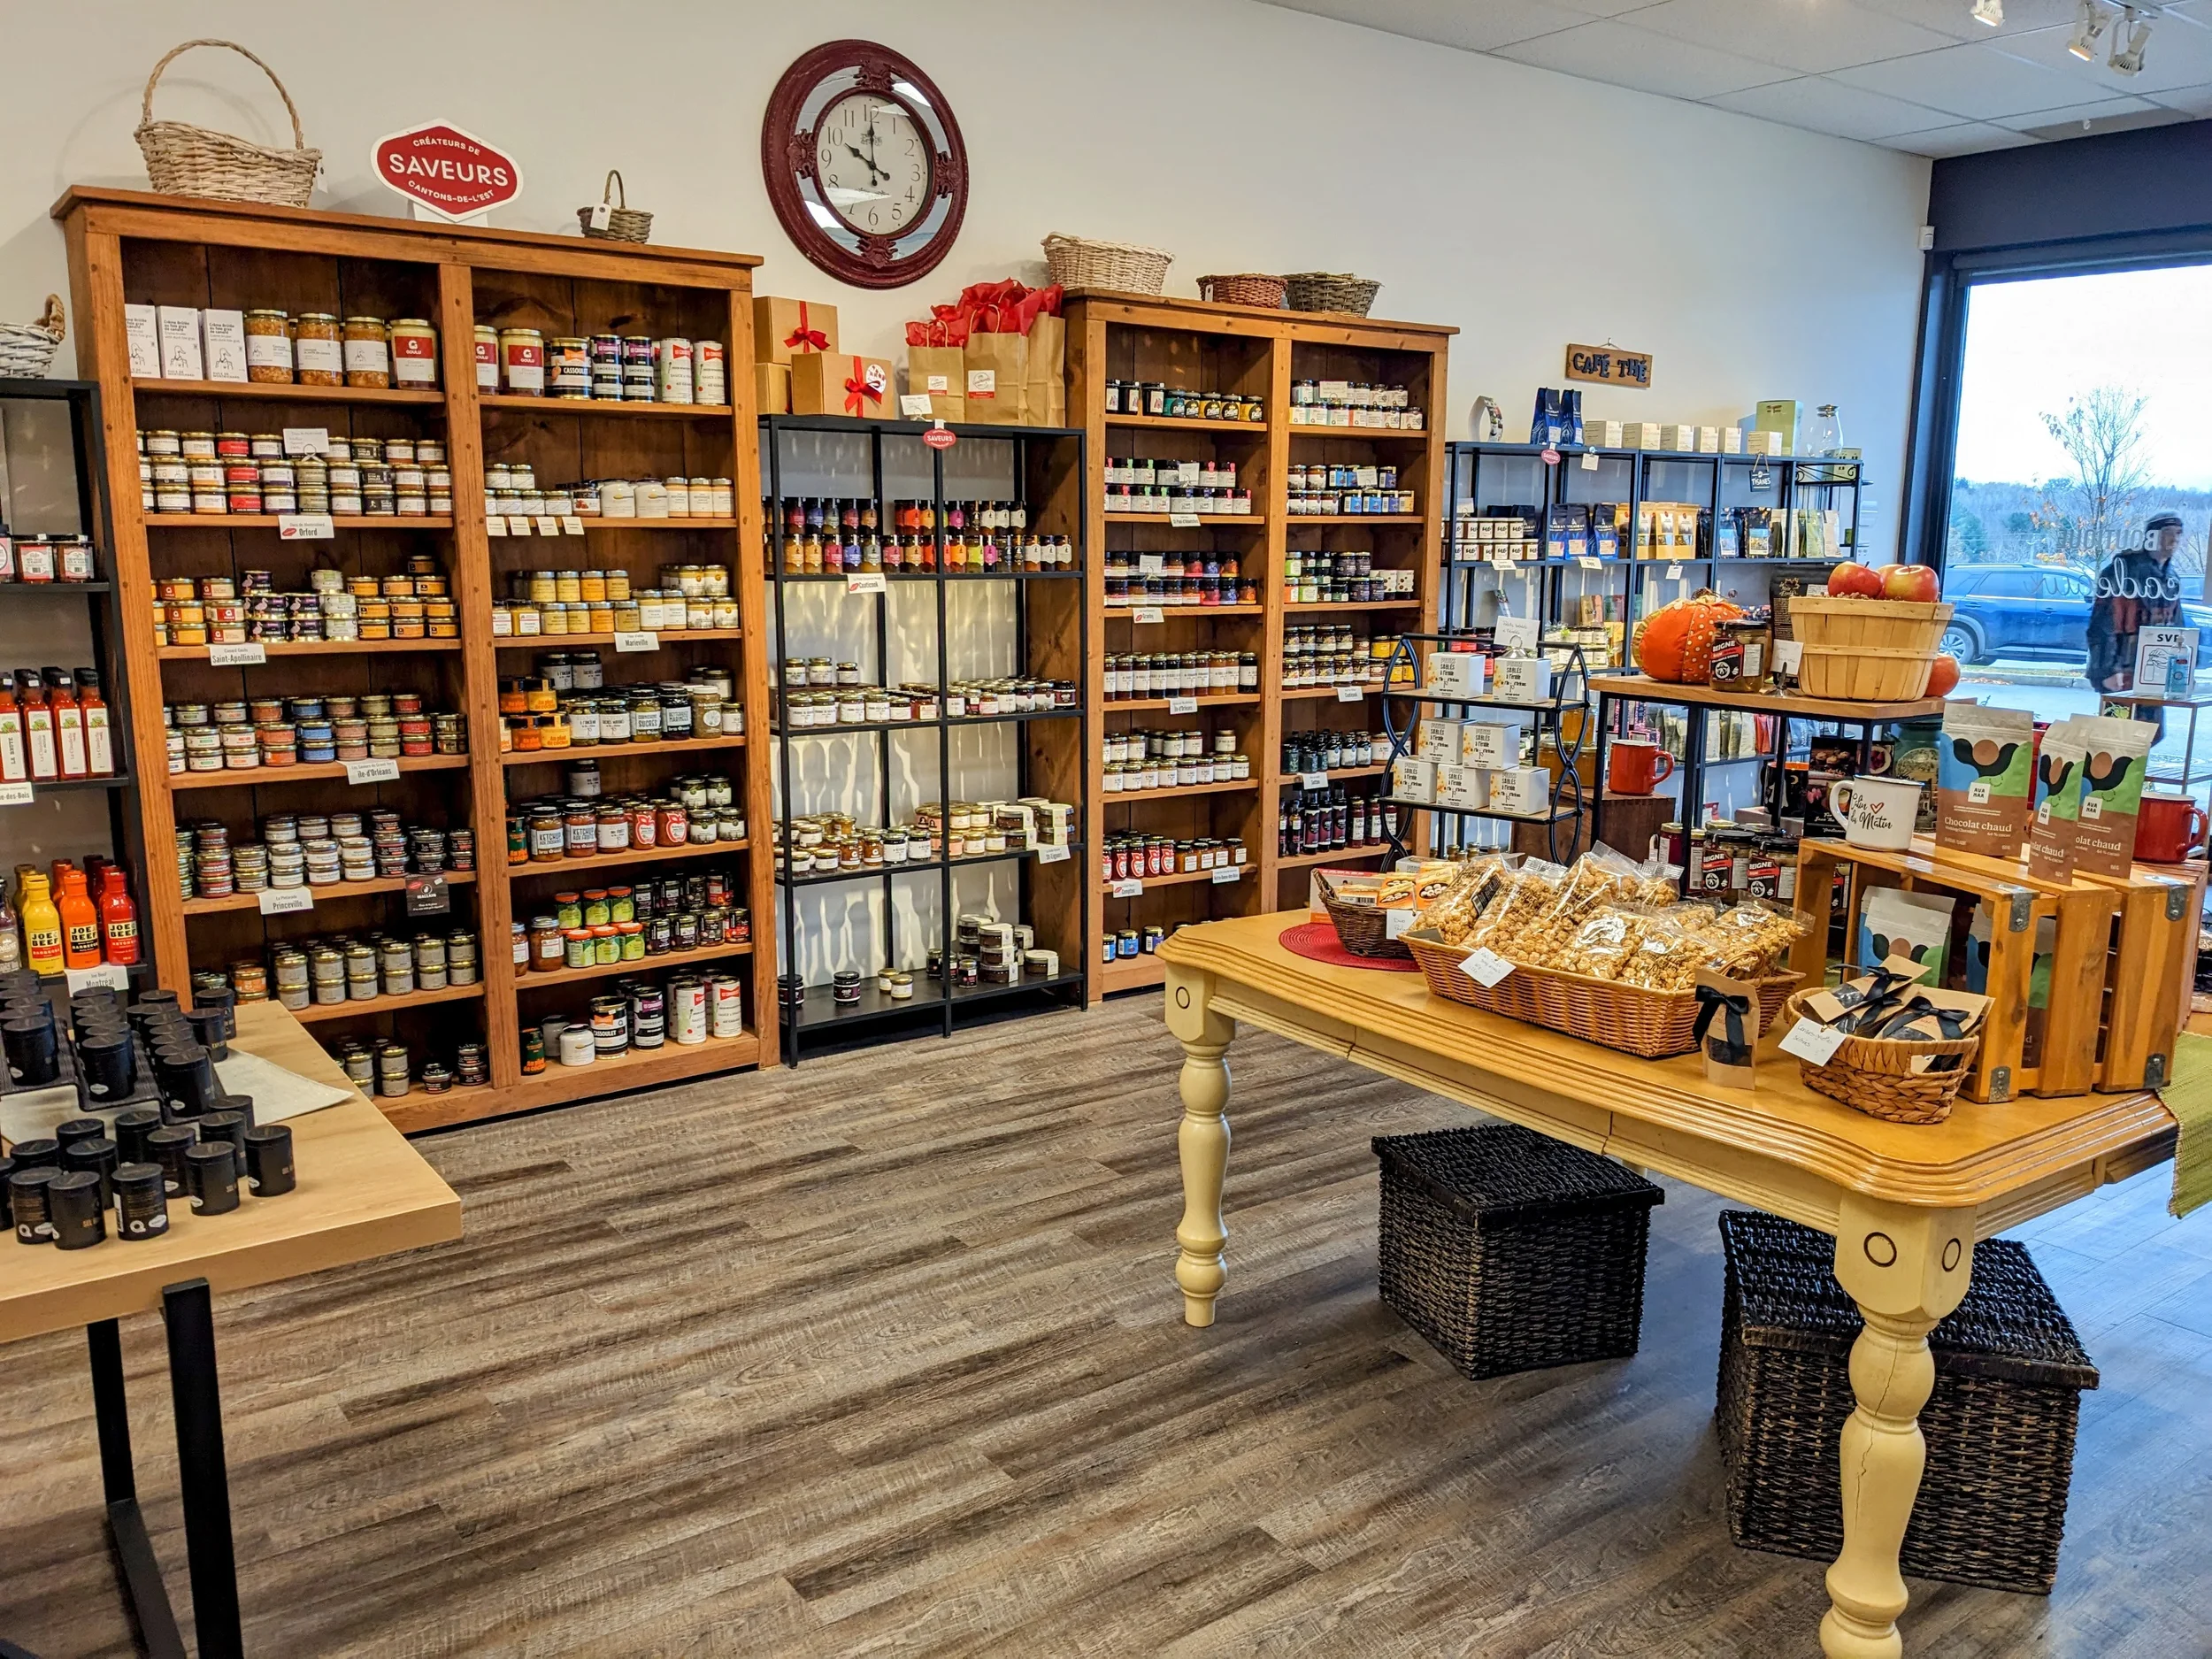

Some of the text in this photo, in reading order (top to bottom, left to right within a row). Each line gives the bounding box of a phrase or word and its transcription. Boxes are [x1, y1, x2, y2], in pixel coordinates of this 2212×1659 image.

[843, 109, 855, 127] 11
[864, 104, 879, 124] 12
[827, 126, 843, 147] 10
[413, 136, 480, 156] CRÉATEURS DE
[904, 138, 915, 157] 2
[821, 149, 832, 169] 9
[389, 153, 509, 187] SAVEURS
[910, 164, 921, 181] 3
[828, 173, 840, 189] 8
[408, 180, 495, 203] CANTONS-DE-L'EST
[904, 186, 915, 203] 4
[868, 206, 879, 226] 6
[892, 203, 902, 220] 5
[1572, 352, 1647, 382] CAFÉ THÉ
[1751, 477, 1771, 486] TISANES
[1713, 641, 1736, 652] BEIGNE
[212, 655, 262, 664] Saint-Apollinaire
[1859, 811, 1893, 830] Matin
[1944, 817, 2012, 833] Chocolat chaud
[2042, 843, 2064, 857] chaud
[2075, 835, 2121, 850] olat chaud
[1703, 853, 1724, 862] BEIGNE
[1749, 861, 1772, 870] BEIGNE
[273, 900, 303, 910] Princeville
[110, 923, 129, 932] JOE
[32, 938, 58, 947] BEEF
[72, 932, 96, 941] BEEF
[86, 978, 114, 989] Montréal
